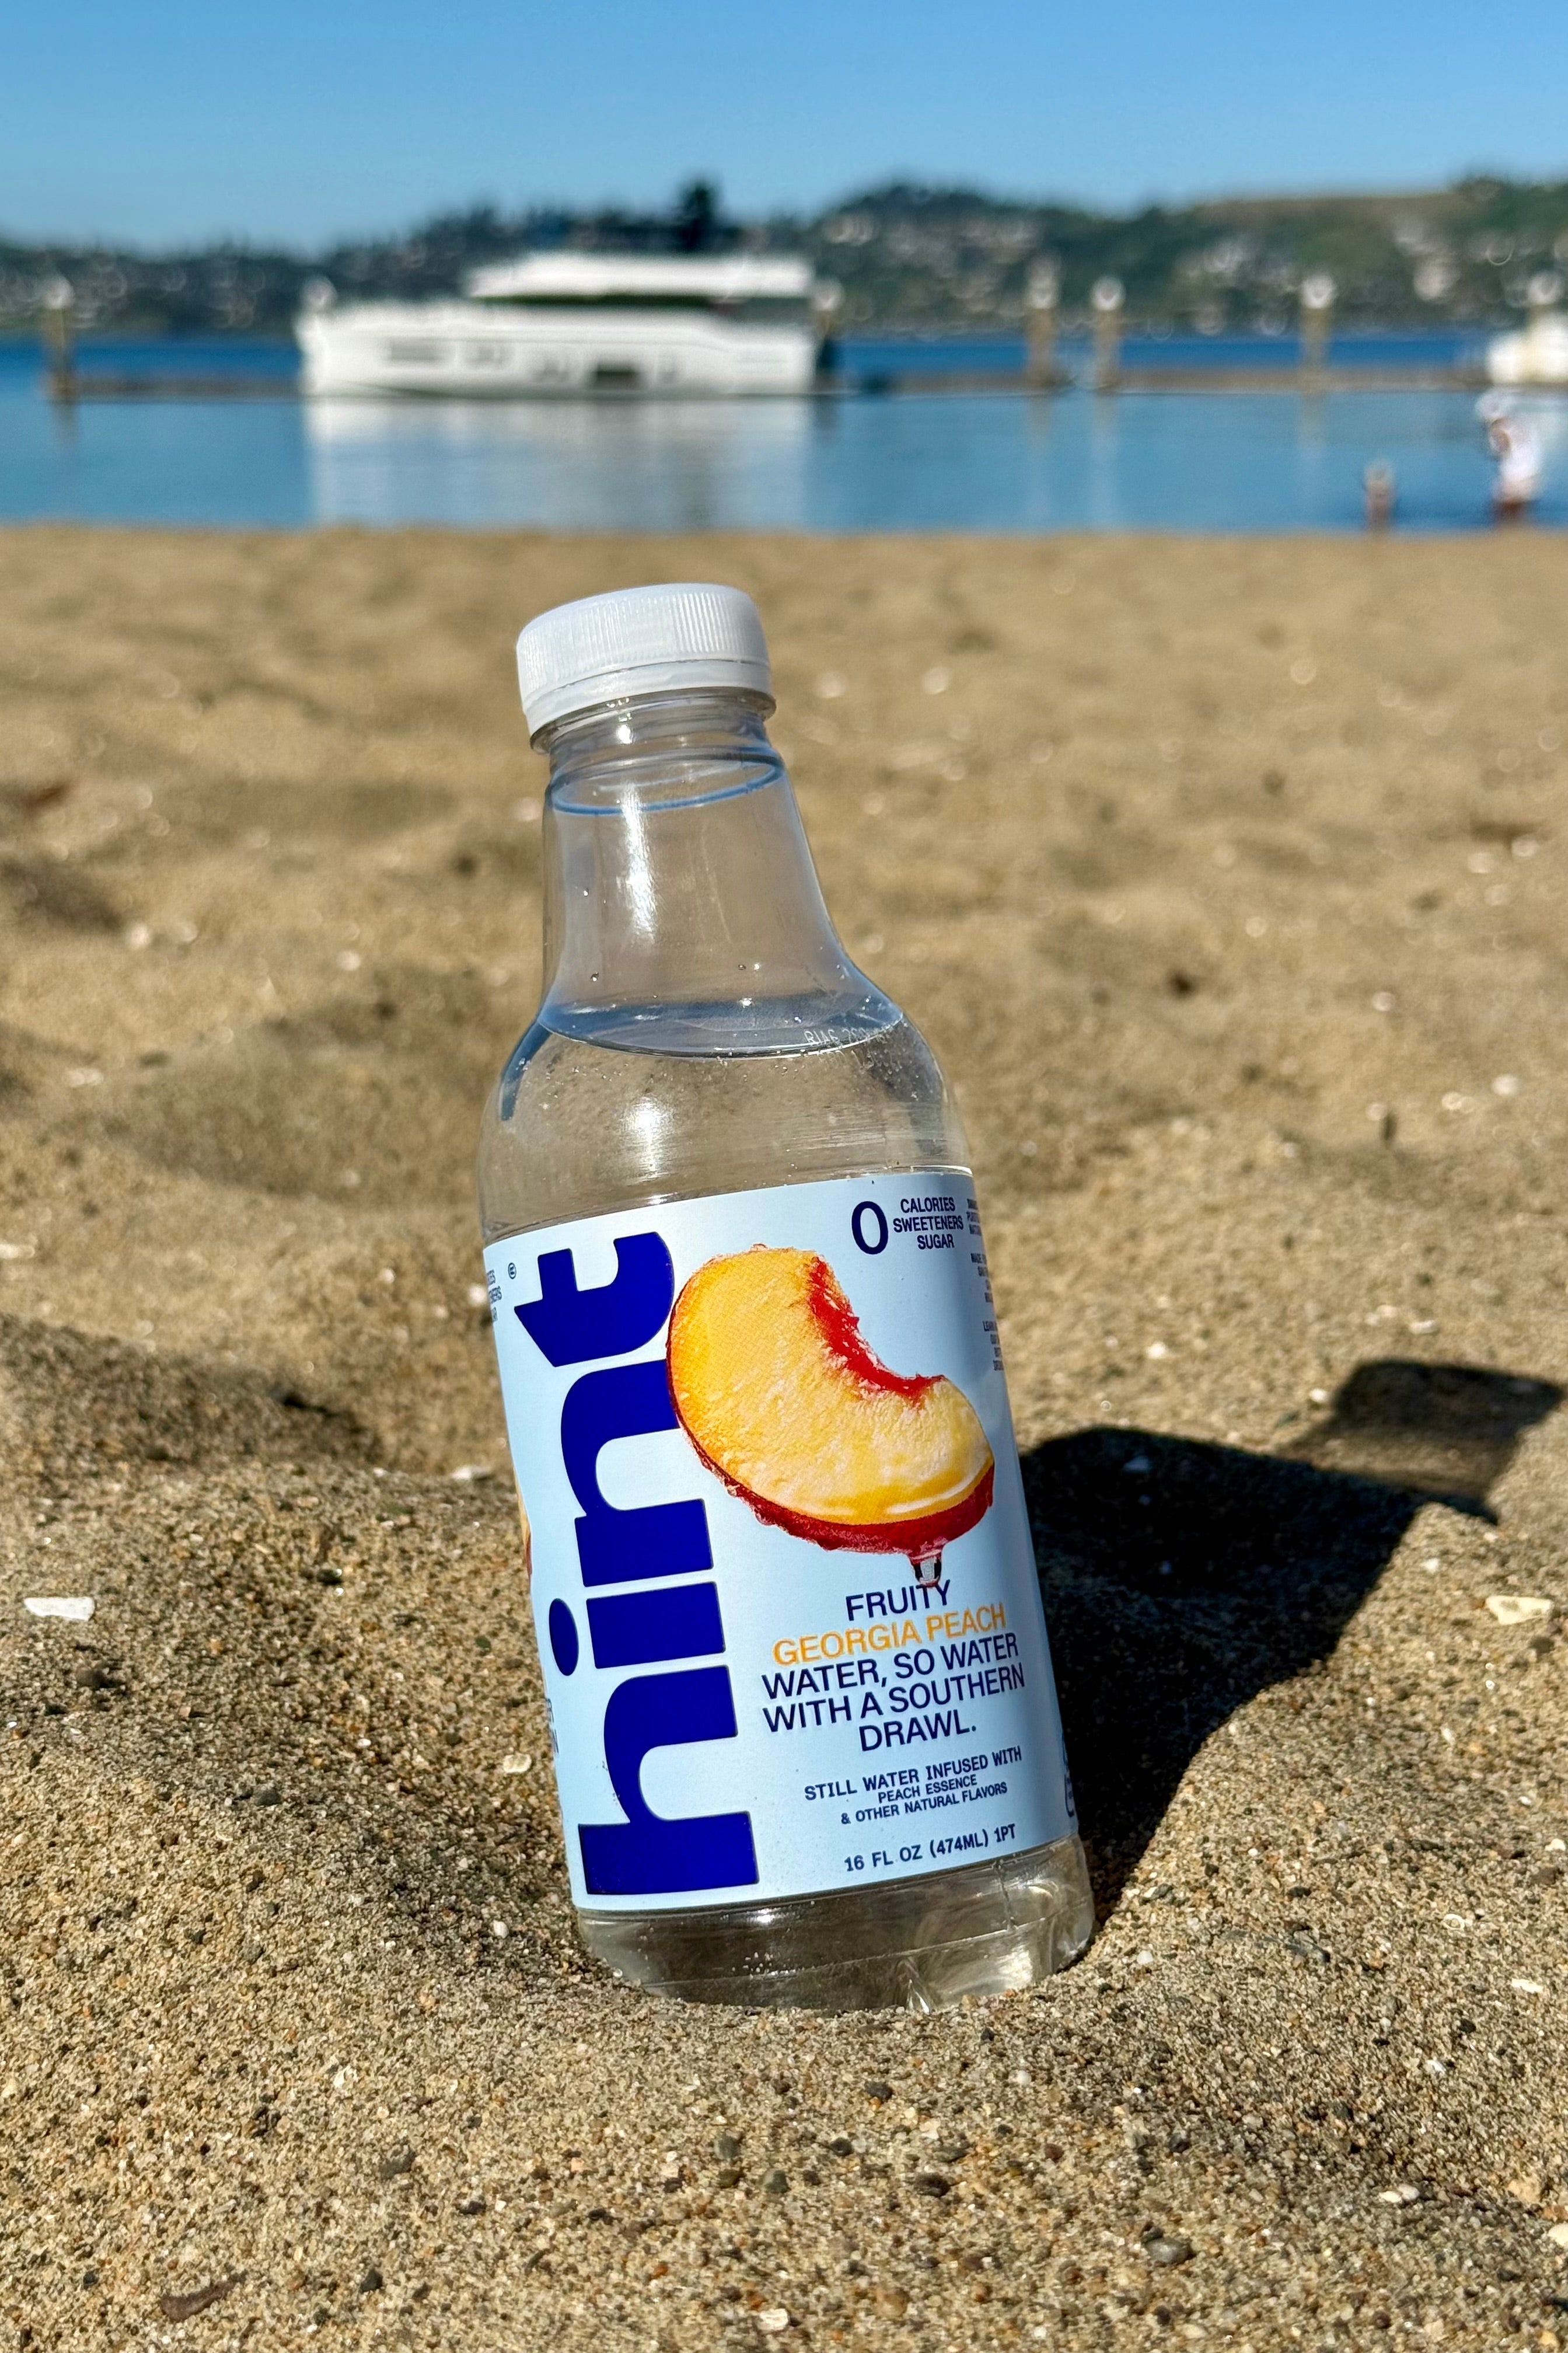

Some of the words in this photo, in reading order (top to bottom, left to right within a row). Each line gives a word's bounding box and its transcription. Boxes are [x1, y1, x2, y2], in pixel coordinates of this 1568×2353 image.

[852, 1201, 888, 1255] 0
[893, 1215, 963, 1233] SWEETENERS
[900, 1197, 955, 1214] CALORIES
[917, 1233, 955, 1250] SUGAR
[514, 1231, 760, 1895] hint
[846, 1580, 951, 1621] FRUITY
[773, 1620, 922, 1665] GEORGIA
[926, 1602, 1007, 1642] PEACH
[762, 1658, 888, 1700] WATER,
[893, 1648, 935, 1679] SO
[941, 1632, 1019, 1671] WATER
[762, 1695, 852, 1732] WITH
[860, 1692, 883, 1719] A
[888, 1662, 1025, 1713] SOUTHERN
[859, 1709, 977, 1752] DRAWL.
[804, 1779, 858, 1801] STILL
[862, 1768, 920, 1791] WATER
[925, 1755, 989, 1780] INFUSED
[991, 1745, 1023, 1767] WITH
[877, 1785, 921, 1804] PEACH
[925, 1773, 977, 1796] ESSENCE
[841, 1813, 851, 1825] &
[855, 1804, 900, 1822] OTHER
[904, 1793, 960, 1814] NATURAL
[962, 1782, 1008, 1803] FLAVORS
[844, 1855, 864, 1871] 16
[872, 1850, 893, 1867] FL
[899, 1844, 923, 1862] OZ
[930, 1828, 989, 1858] (474ML)
[994, 1823, 1016, 1843] 1PT
